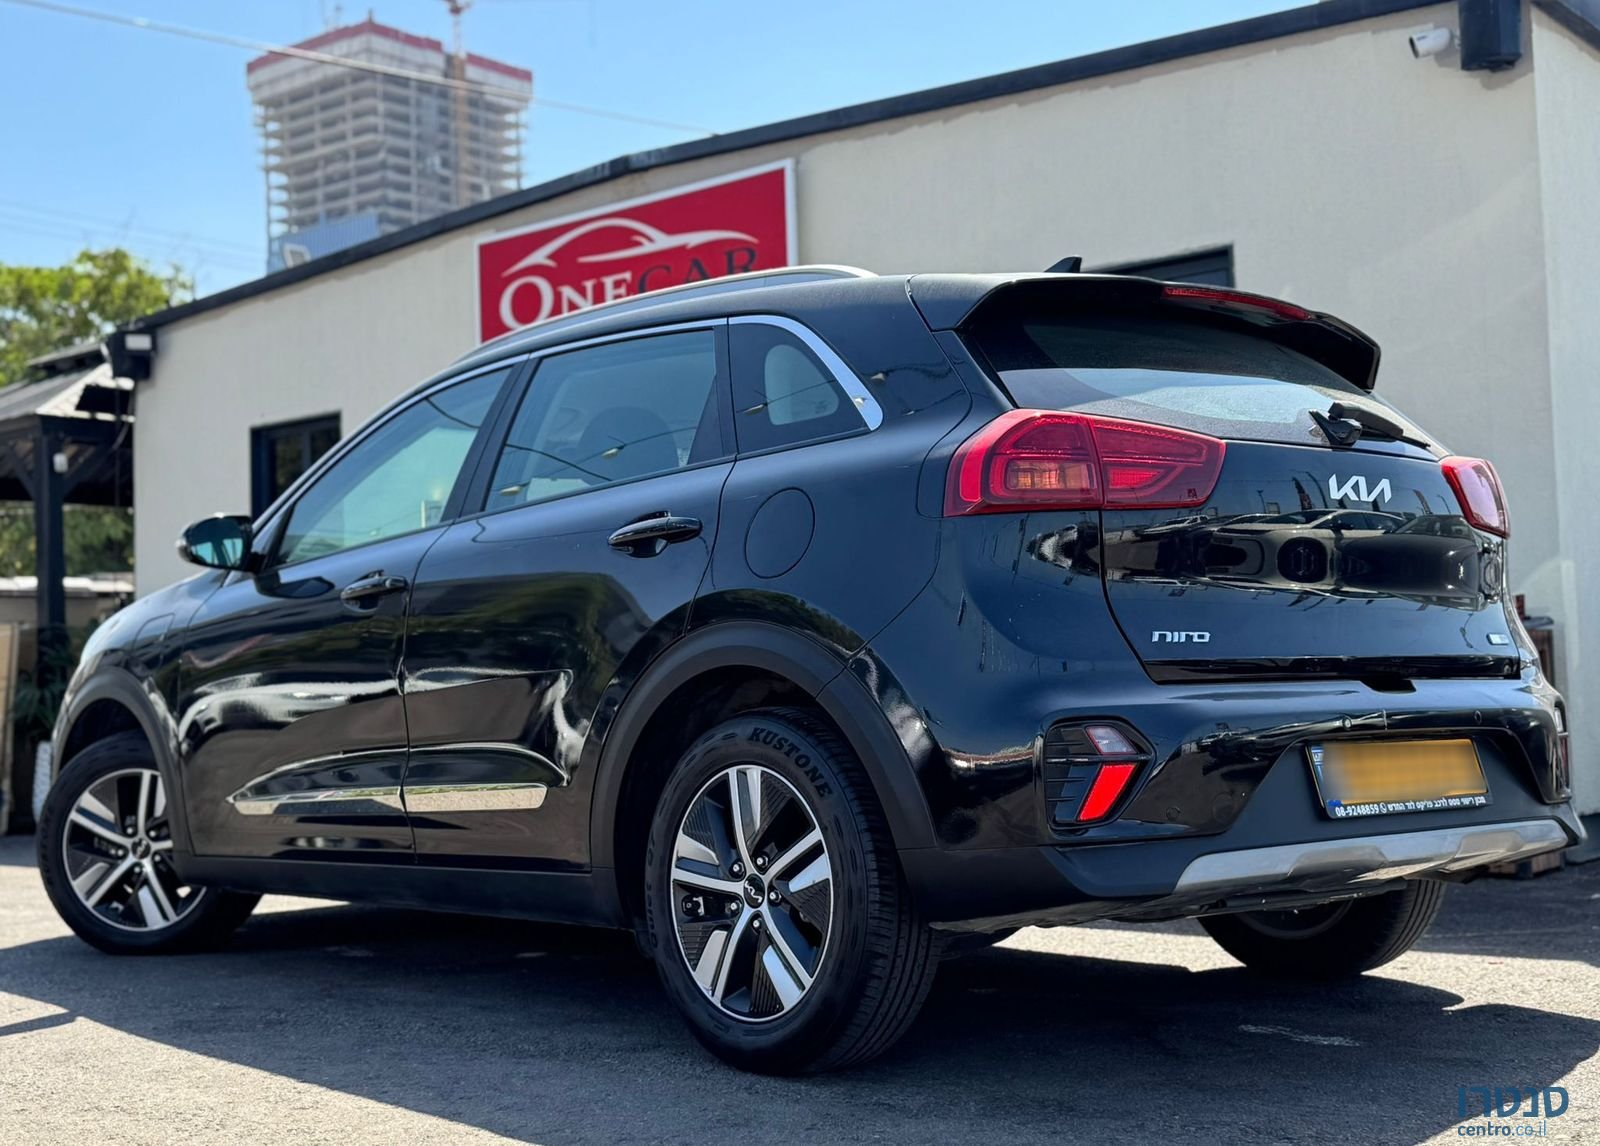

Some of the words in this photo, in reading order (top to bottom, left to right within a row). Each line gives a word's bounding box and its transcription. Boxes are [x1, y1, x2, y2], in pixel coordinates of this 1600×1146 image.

[1328, 473, 1392, 503] KIA
[747, 727, 833, 798] KUSTONE
[1335, 803, 1380, 817] 08-9248859
[1433, 797, 1448, 807] לרכב
